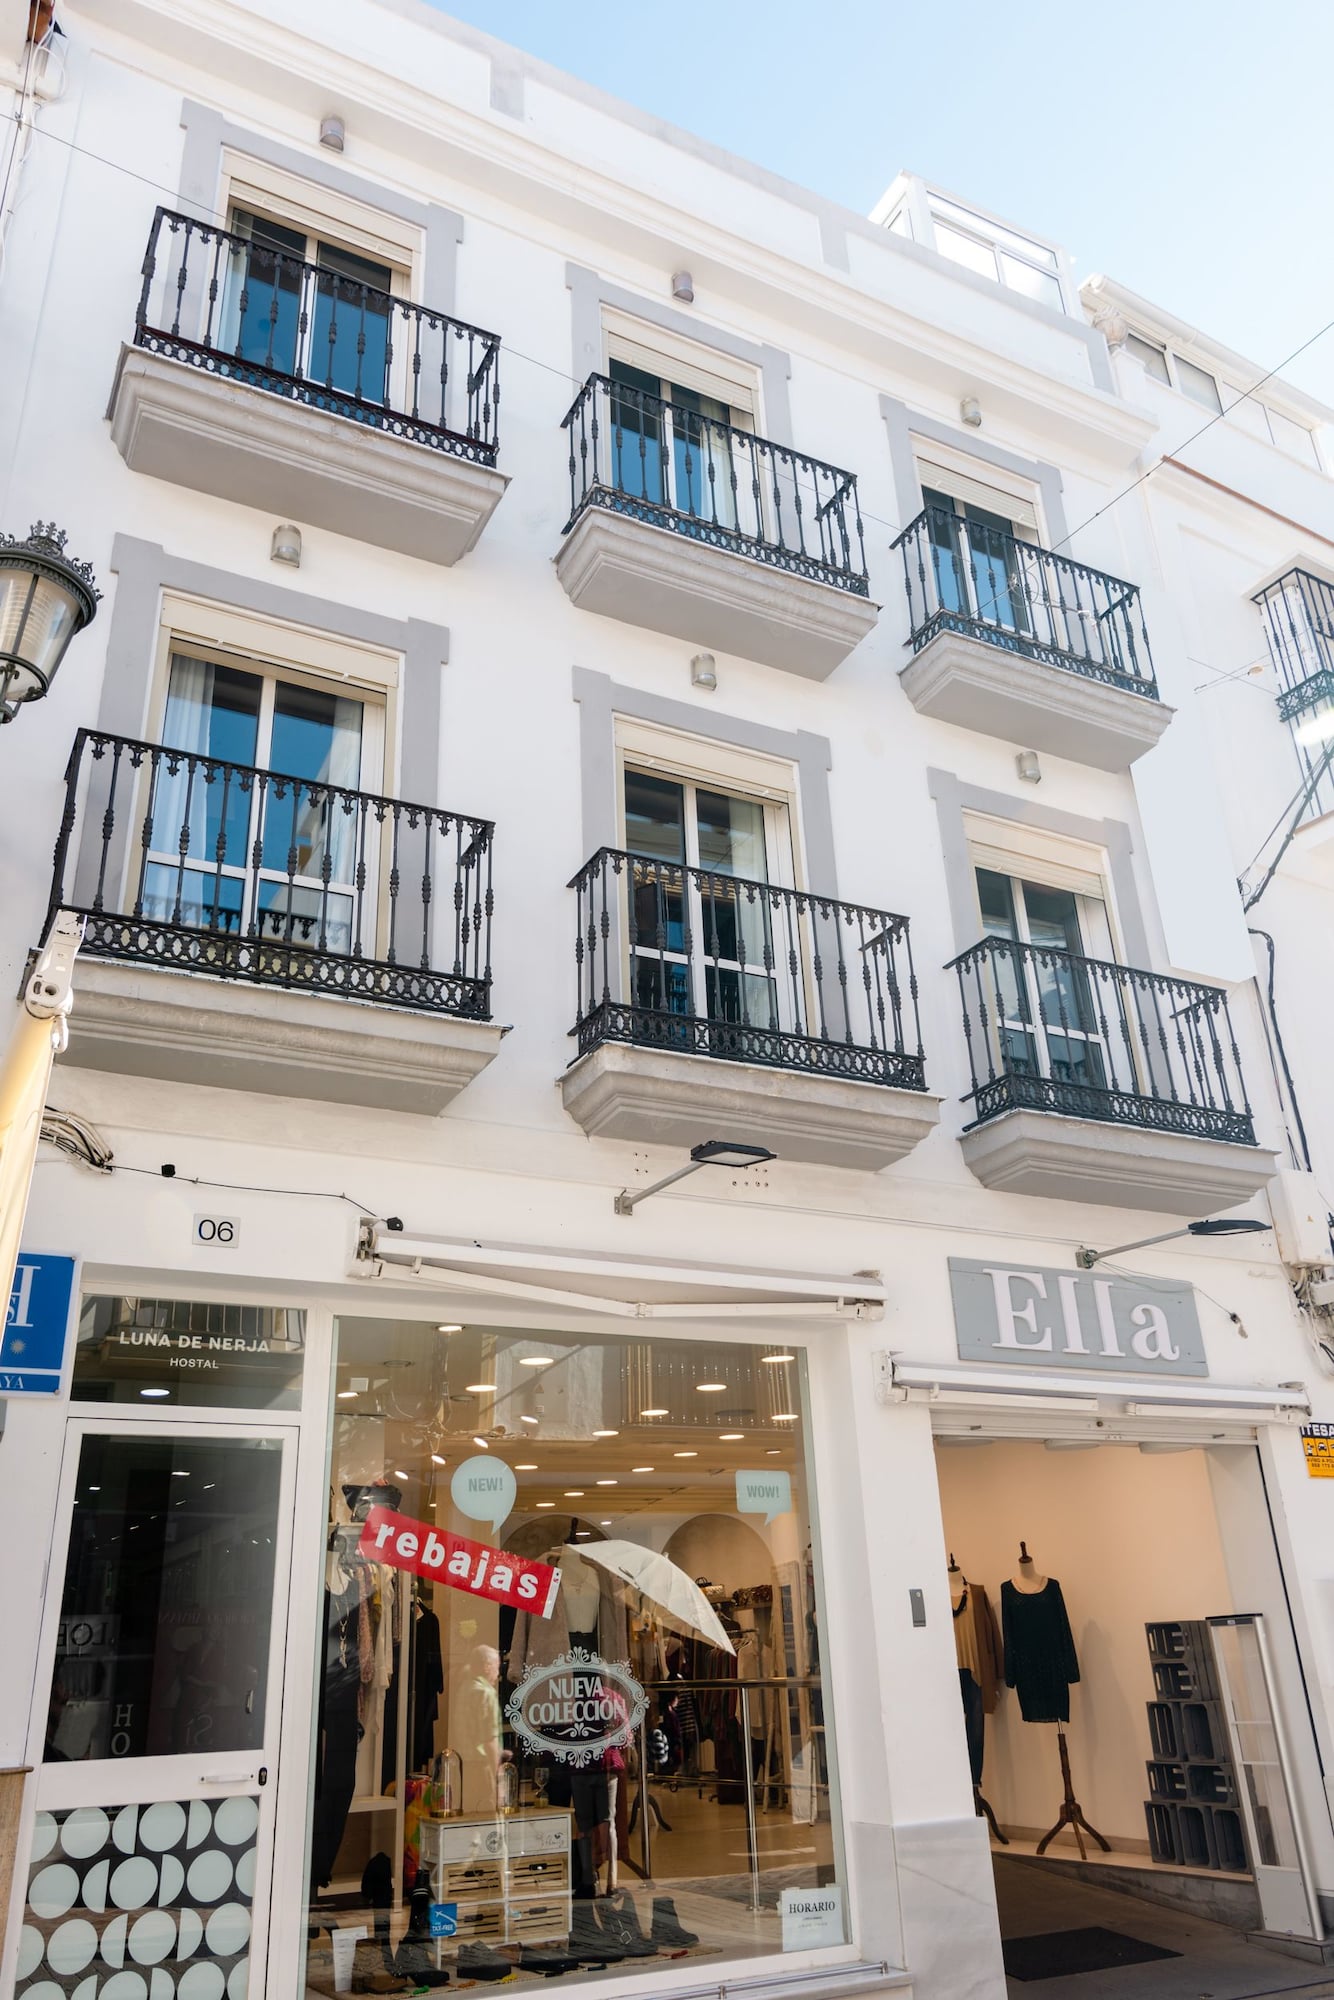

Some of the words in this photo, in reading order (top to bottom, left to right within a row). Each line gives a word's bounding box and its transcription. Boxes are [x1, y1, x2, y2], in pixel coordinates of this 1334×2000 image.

[198, 1219, 234, 1242] 06
[982, 1268, 1180, 1361] Ella
[119, 1331, 171, 1347] LUNA
[178, 1335, 202, 1348] DE
[209, 1337, 269, 1353] NERJA
[169, 1357, 219, 1369] HOSTAL
[0, 1376, 24, 1389] YA
[467, 1477, 503, 1493] NEW!
[746, 1485, 780, 1499] WOW!
[374, 1522, 538, 1600] rebajas
[548, 1676, 605, 1699] NUEVA
[528, 1695, 626, 1726] COLECCIÓN
[789, 1901, 836, 1914] HORARIO
